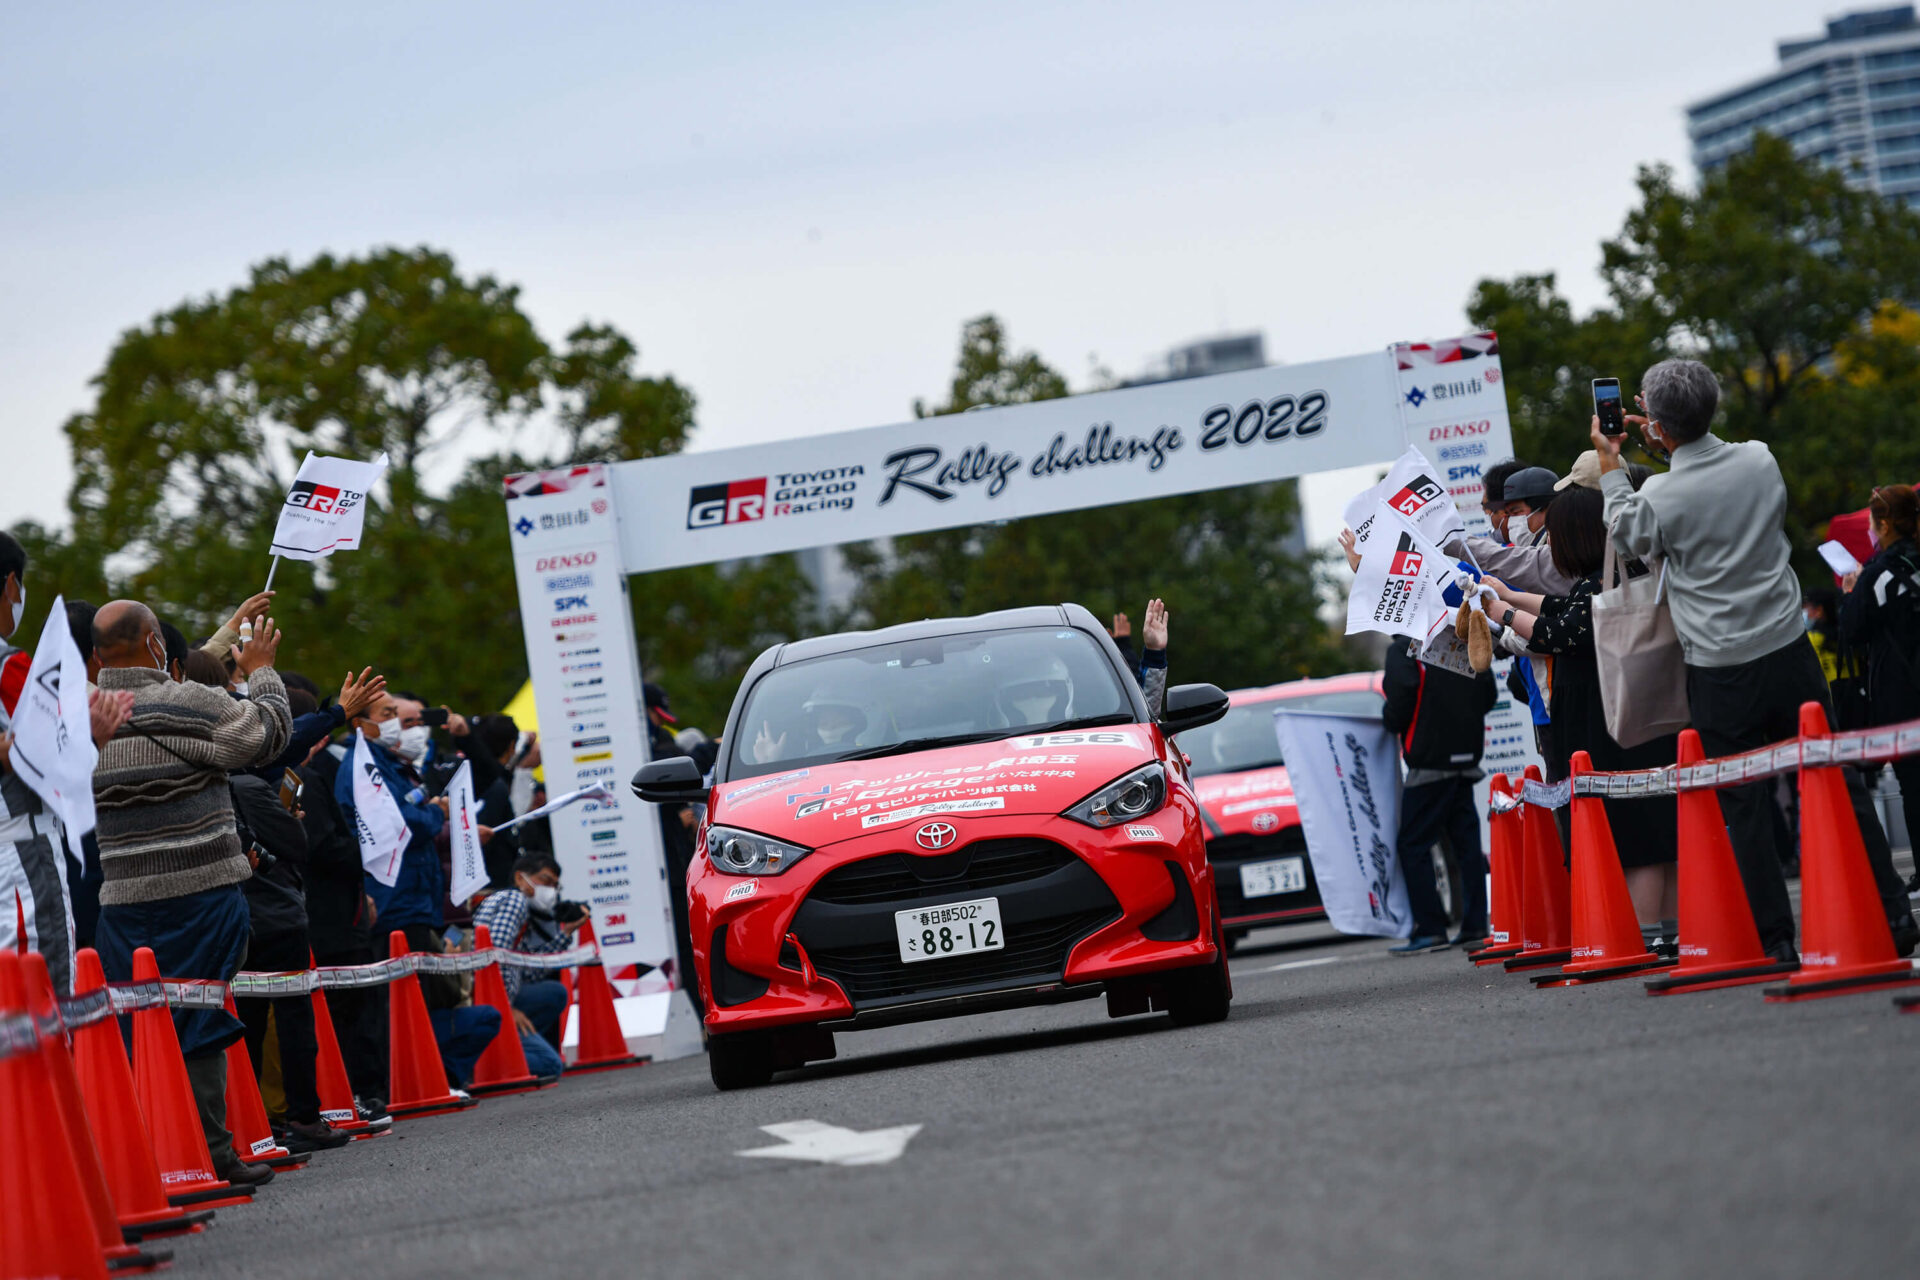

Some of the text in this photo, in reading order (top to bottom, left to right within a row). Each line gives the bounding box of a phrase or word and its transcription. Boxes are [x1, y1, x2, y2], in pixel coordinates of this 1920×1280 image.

[1429, 419, 1490, 441] DENSO
[878, 391, 1328, 505] Rally challenge 2022
[775, 465, 865, 487] TOYOTA
[1448, 464, 1483, 480] SPK
[286, 484, 340, 513] GR
[774, 481, 857, 501] GAZOO
[688, 485, 766, 529] GR
[773, 497, 855, 517] Racing
[536, 551, 597, 573] DENSO
[554, 595, 589, 612] SPK
[1028, 733, 1125, 746] 156
[856, 776, 985, 801] Garage
[833, 803, 872, 820] トヨタ
[1132, 829, 1155, 837] PRO
[730, 885, 751, 898] PRO
[605, 914, 627, 927] 3M
[908, 920, 998, 955] さ 88-12
